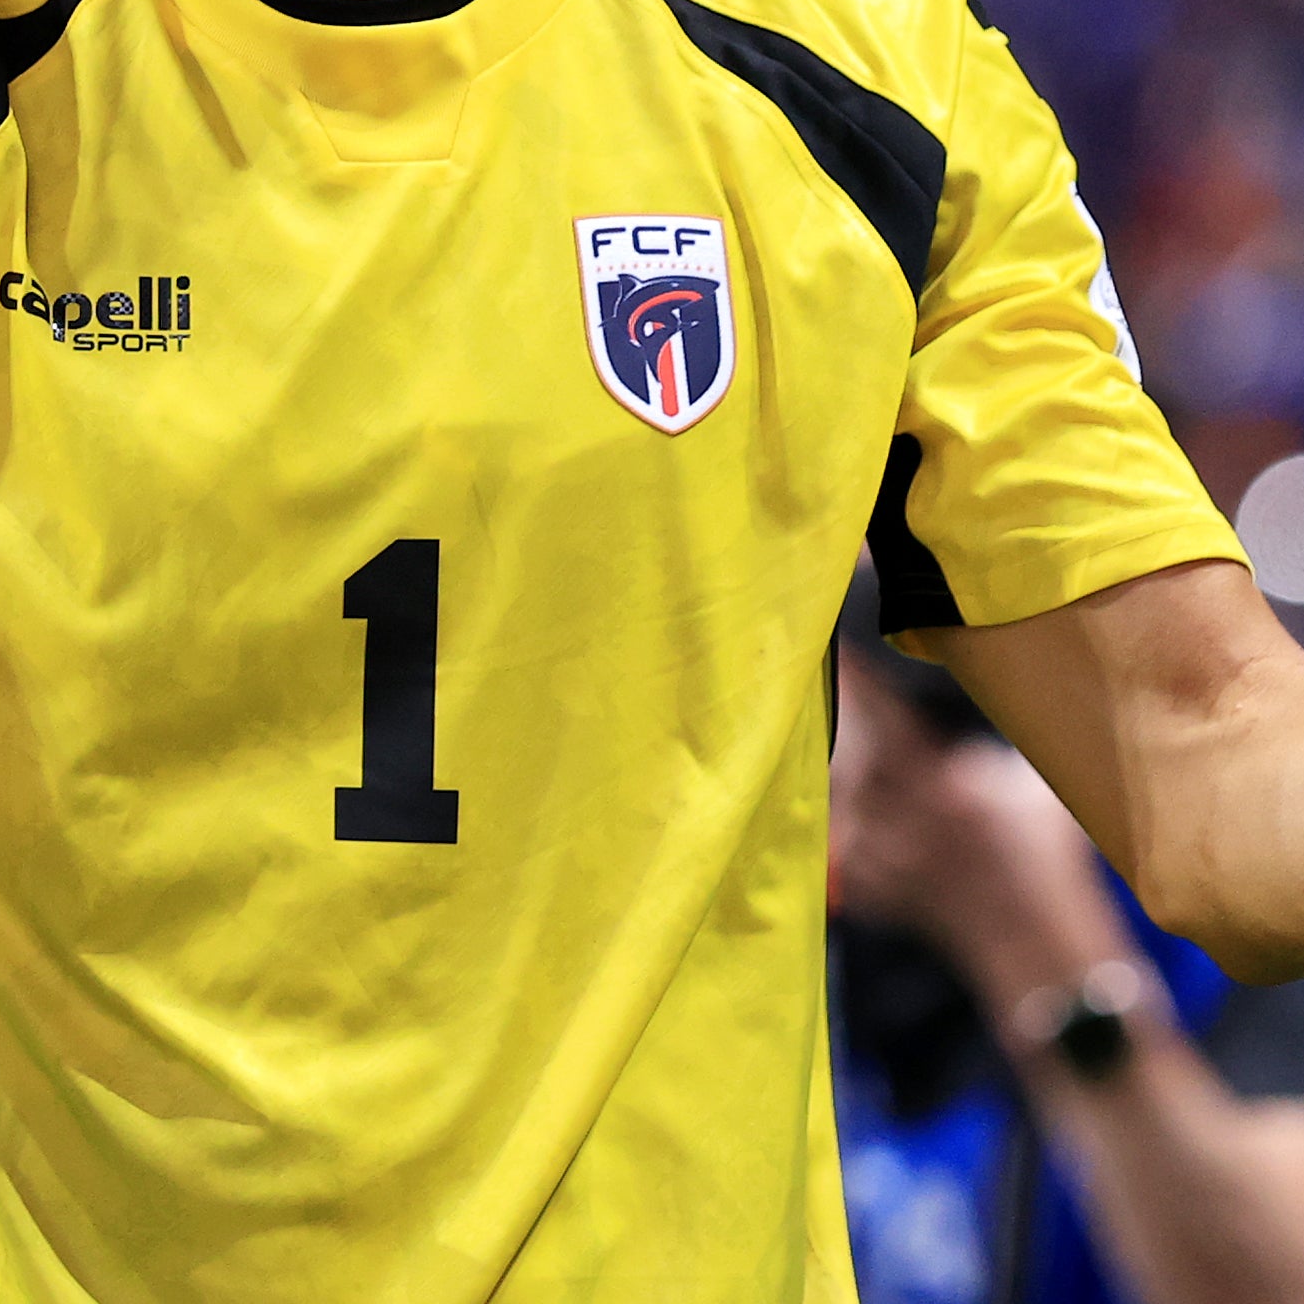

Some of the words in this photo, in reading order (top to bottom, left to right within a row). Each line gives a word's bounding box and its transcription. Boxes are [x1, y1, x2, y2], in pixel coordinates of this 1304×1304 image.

[591, 226, 711, 258] FCF
[73, 332, 191, 352] SPORT
[334, 538, 459, 844] 1
